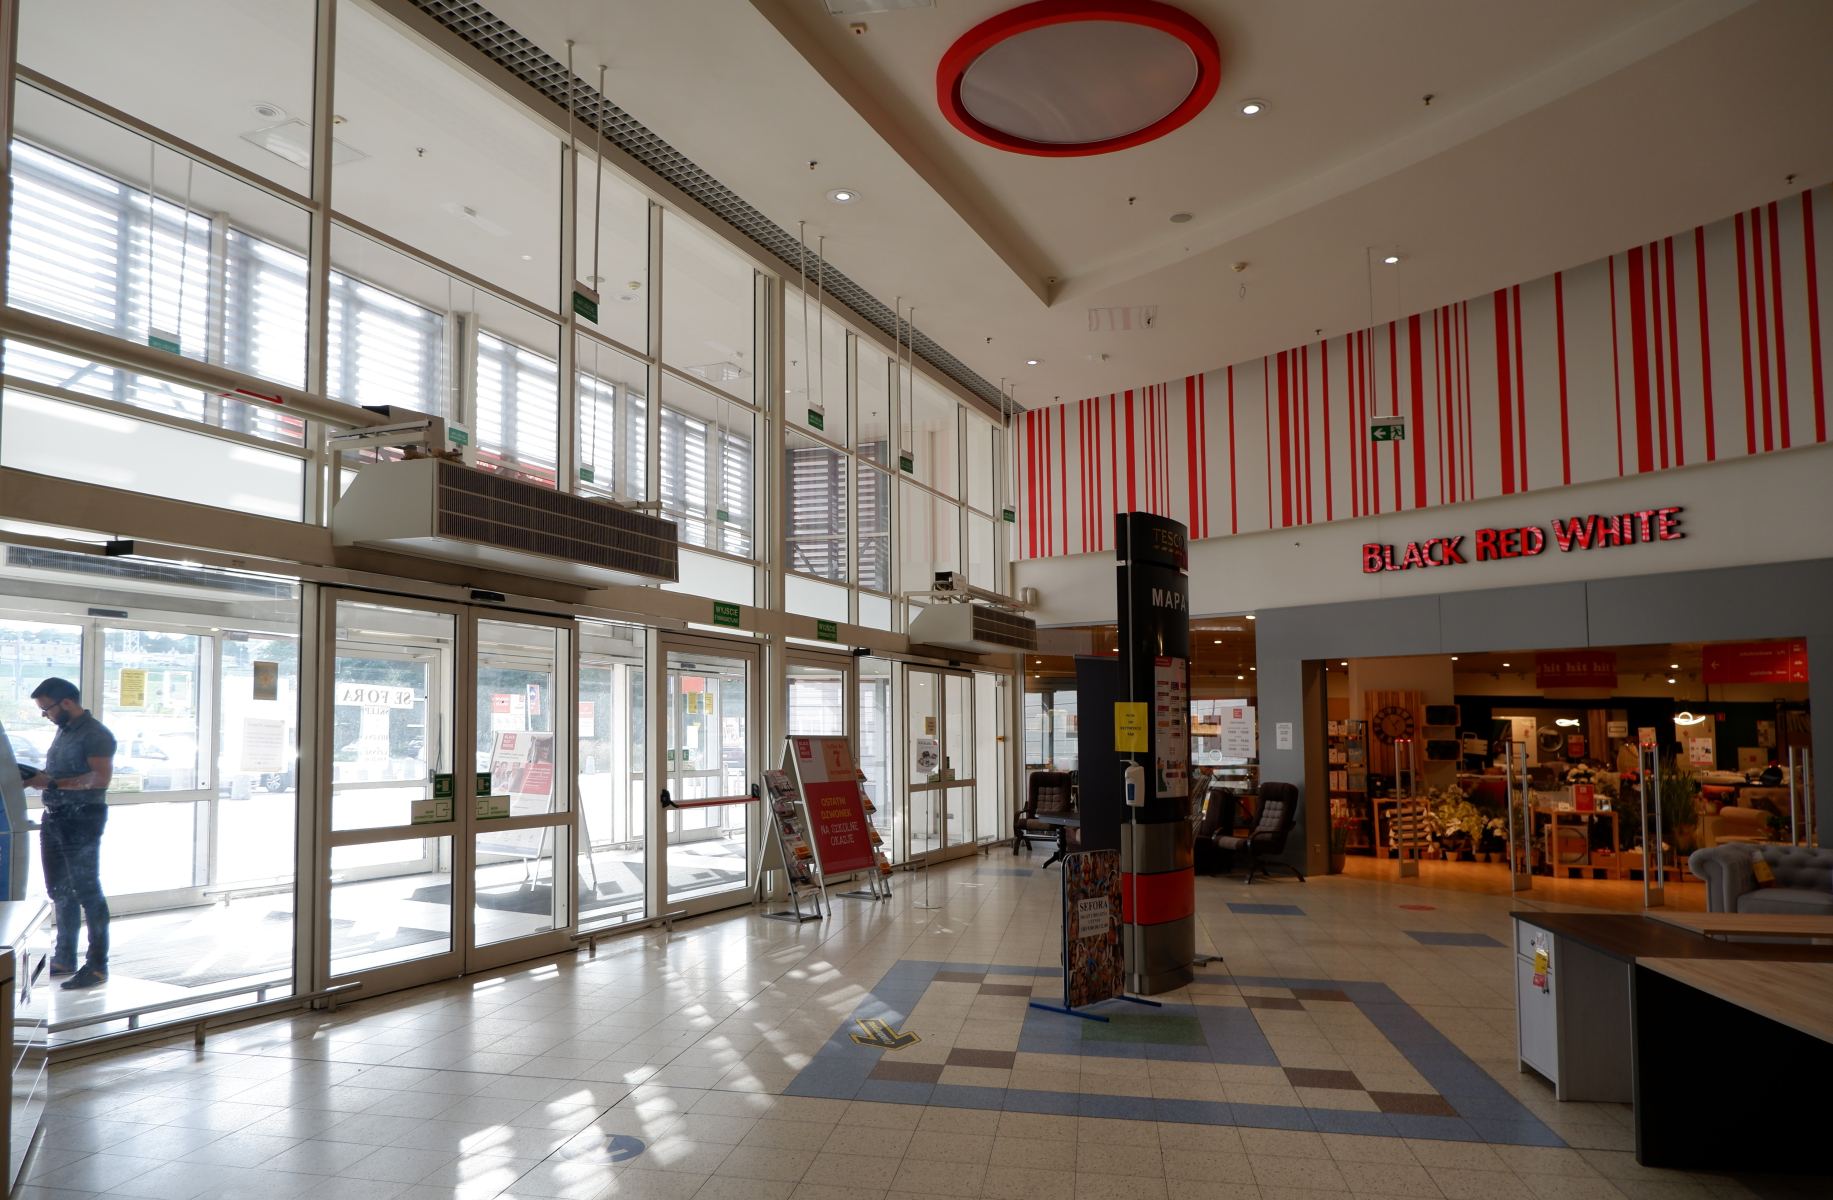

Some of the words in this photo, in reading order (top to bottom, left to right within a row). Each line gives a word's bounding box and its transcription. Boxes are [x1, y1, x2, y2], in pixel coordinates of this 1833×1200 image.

[1152, 528, 1184, 548] TESCO
[1363, 535, 1467, 573] BLACK
[1475, 526, 1546, 561] RED
[1551, 505, 1686, 552] WHITE
[1152, 587, 1187, 612] MAPA
[1080, 900, 1108, 912] SEFORA
